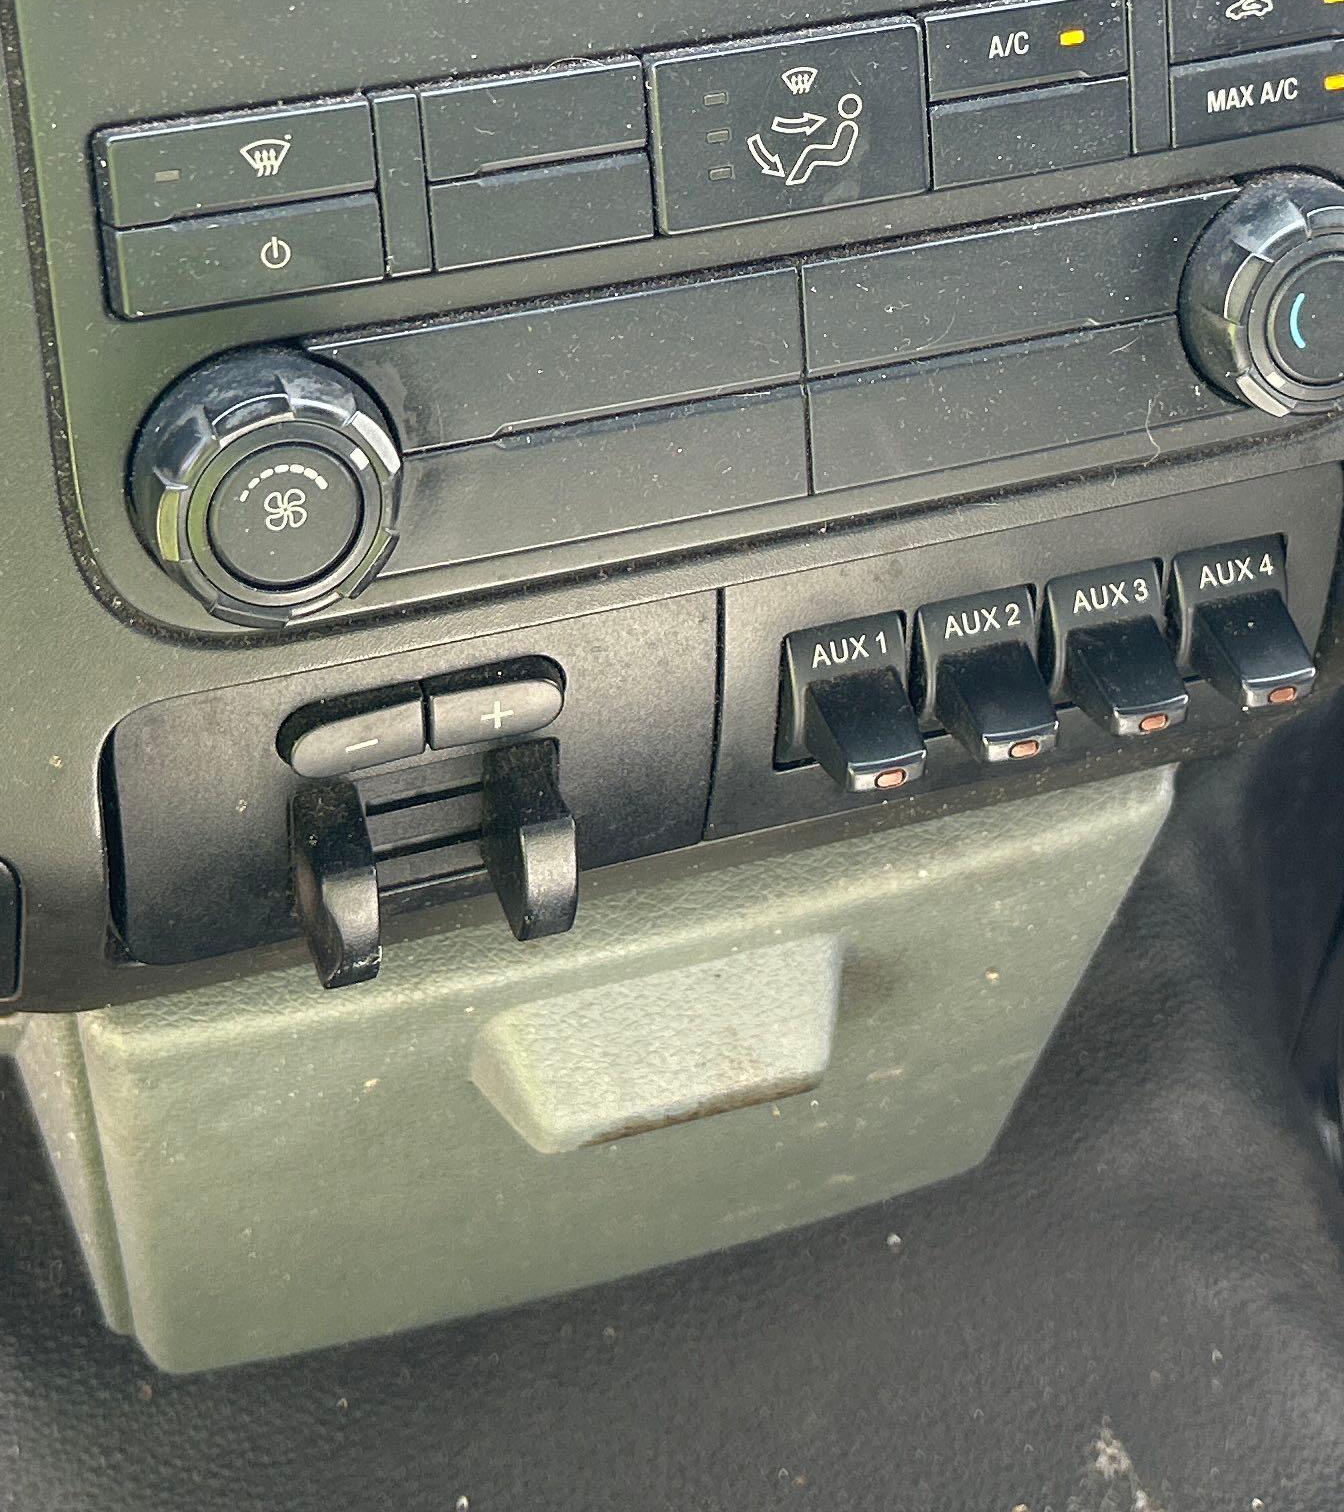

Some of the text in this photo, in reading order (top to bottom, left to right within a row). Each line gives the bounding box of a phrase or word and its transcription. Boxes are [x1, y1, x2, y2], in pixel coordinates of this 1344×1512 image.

[987, 31, 1031, 60] A/C
[1206, 76, 1299, 114] MAX A/C
[1197, 553, 1274, 590] AUX 4
[1072, 577, 1150, 615] AUX 3
[943, 602, 1022, 640] AUX 2
[811, 631, 888, 669] AUX 1
